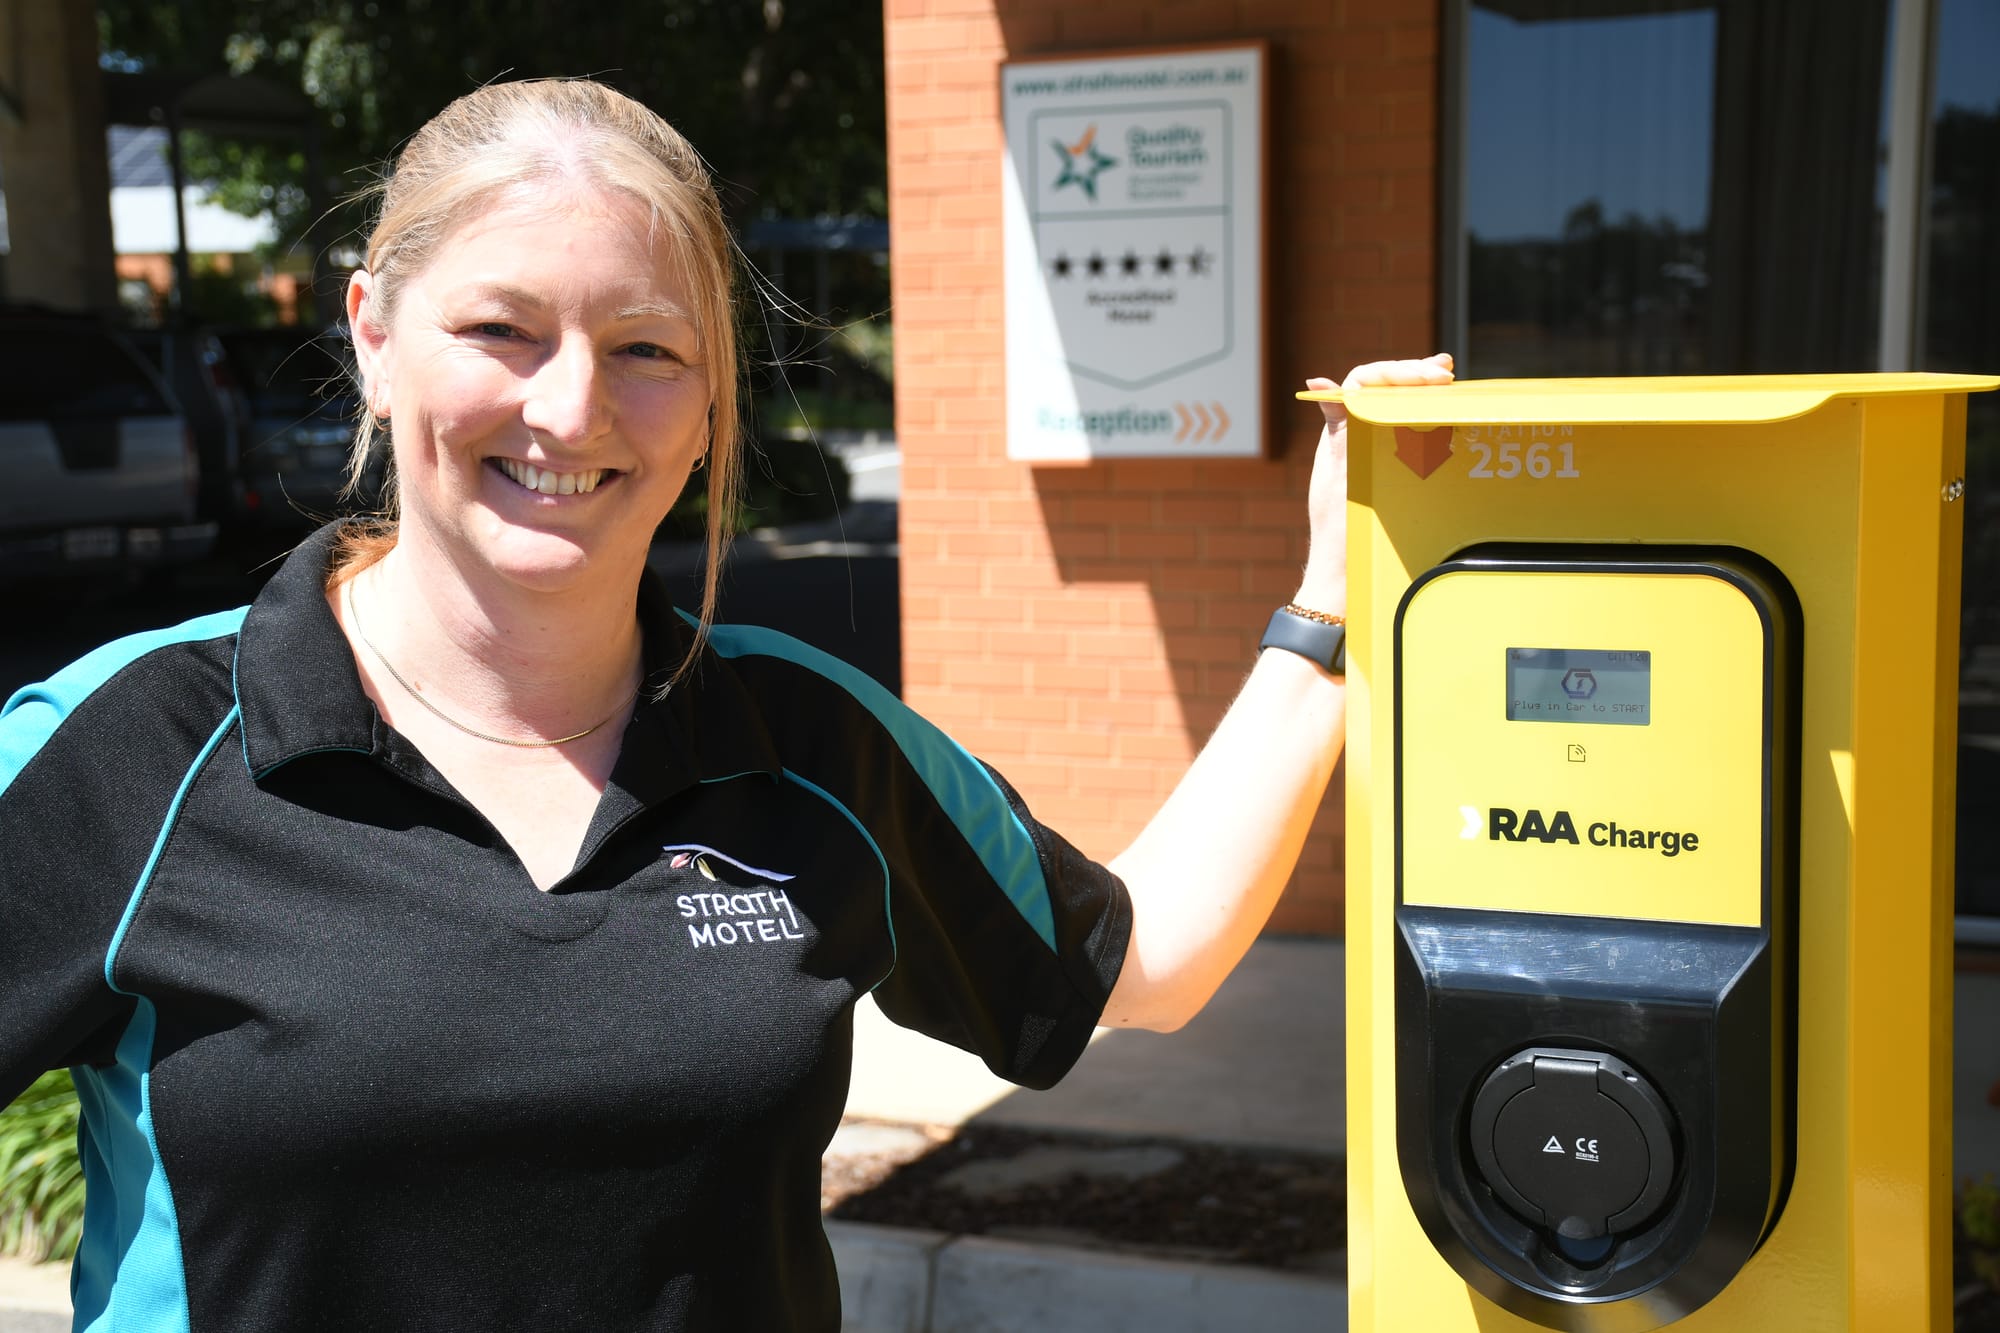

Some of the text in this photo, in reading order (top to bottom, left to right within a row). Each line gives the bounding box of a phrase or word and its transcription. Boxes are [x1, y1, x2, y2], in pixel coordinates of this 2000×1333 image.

[1126, 124, 1203, 146] Quality
[1128, 146, 1207, 167] Tourism
[1036, 404, 1173, 437] Reception
[1468, 442, 1580, 479] 2561
[1514, 701, 1645, 713] Plug in Car to START
[1489, 808, 1699, 857] RAA Charge
[688, 918, 804, 948] MOTEL
